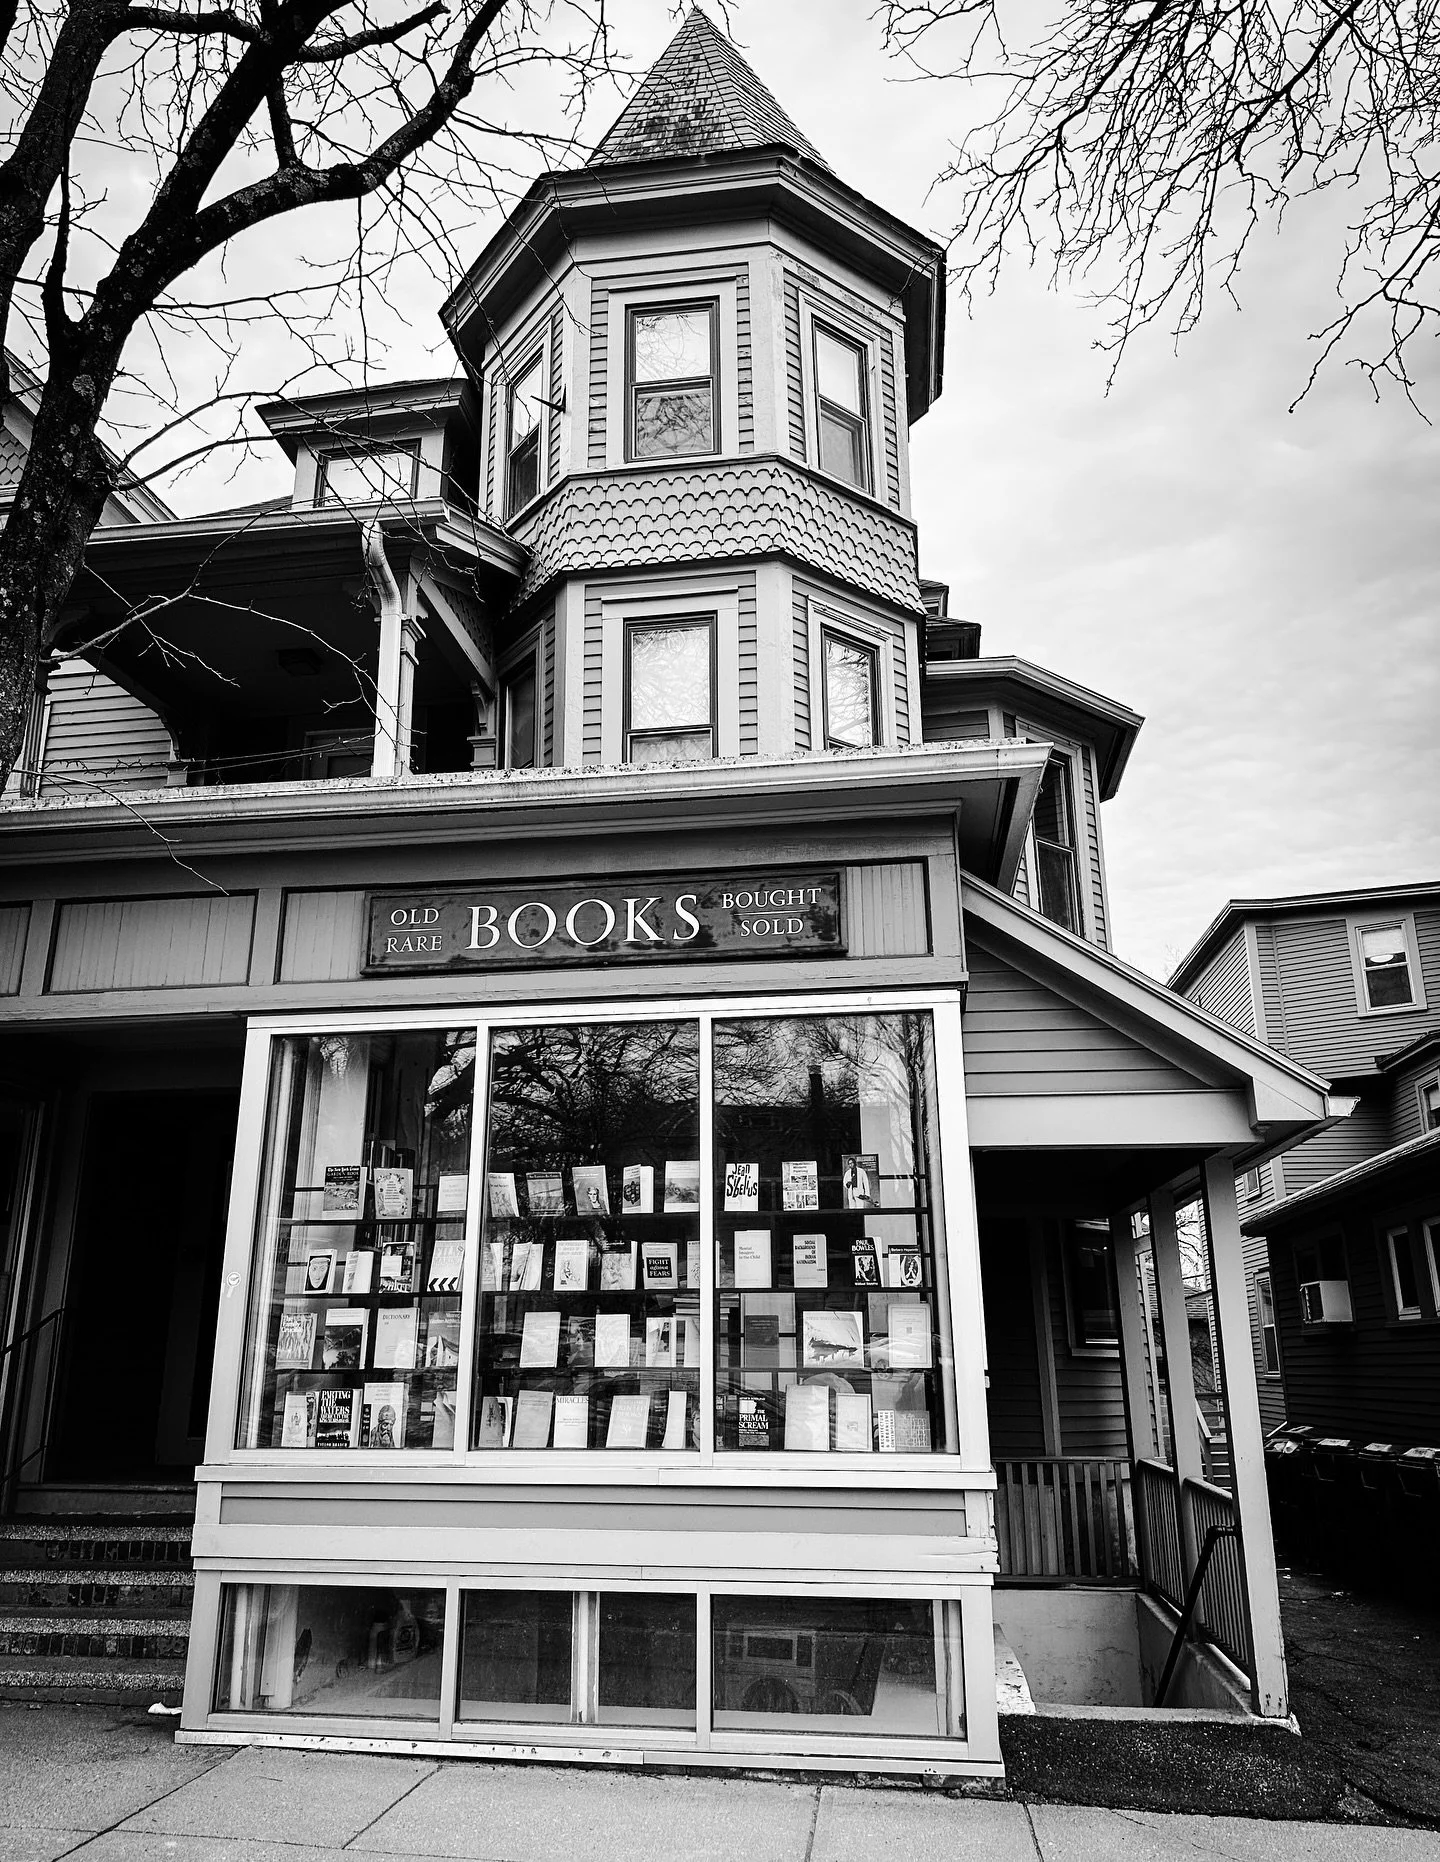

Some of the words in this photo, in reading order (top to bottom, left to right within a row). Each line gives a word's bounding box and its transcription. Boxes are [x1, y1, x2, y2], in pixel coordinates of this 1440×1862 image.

[721, 887, 822, 909] BOUGHT
[390, 908, 440, 926] OLD
[464, 894, 701, 950] BOOKS
[740, 917, 805, 937] SOLD
[385, 934, 443, 954] RARE
[851, 1244, 875, 1252] BOWLES
[321, 1390, 351, 1399] PARTING
[556, 1396, 589, 1404] MIRACLES
[320, 1405, 350, 1415] WATERS
[739, 1413, 768, 1422] PRIMAL
[738, 1421, 769, 1430] SCREAM
